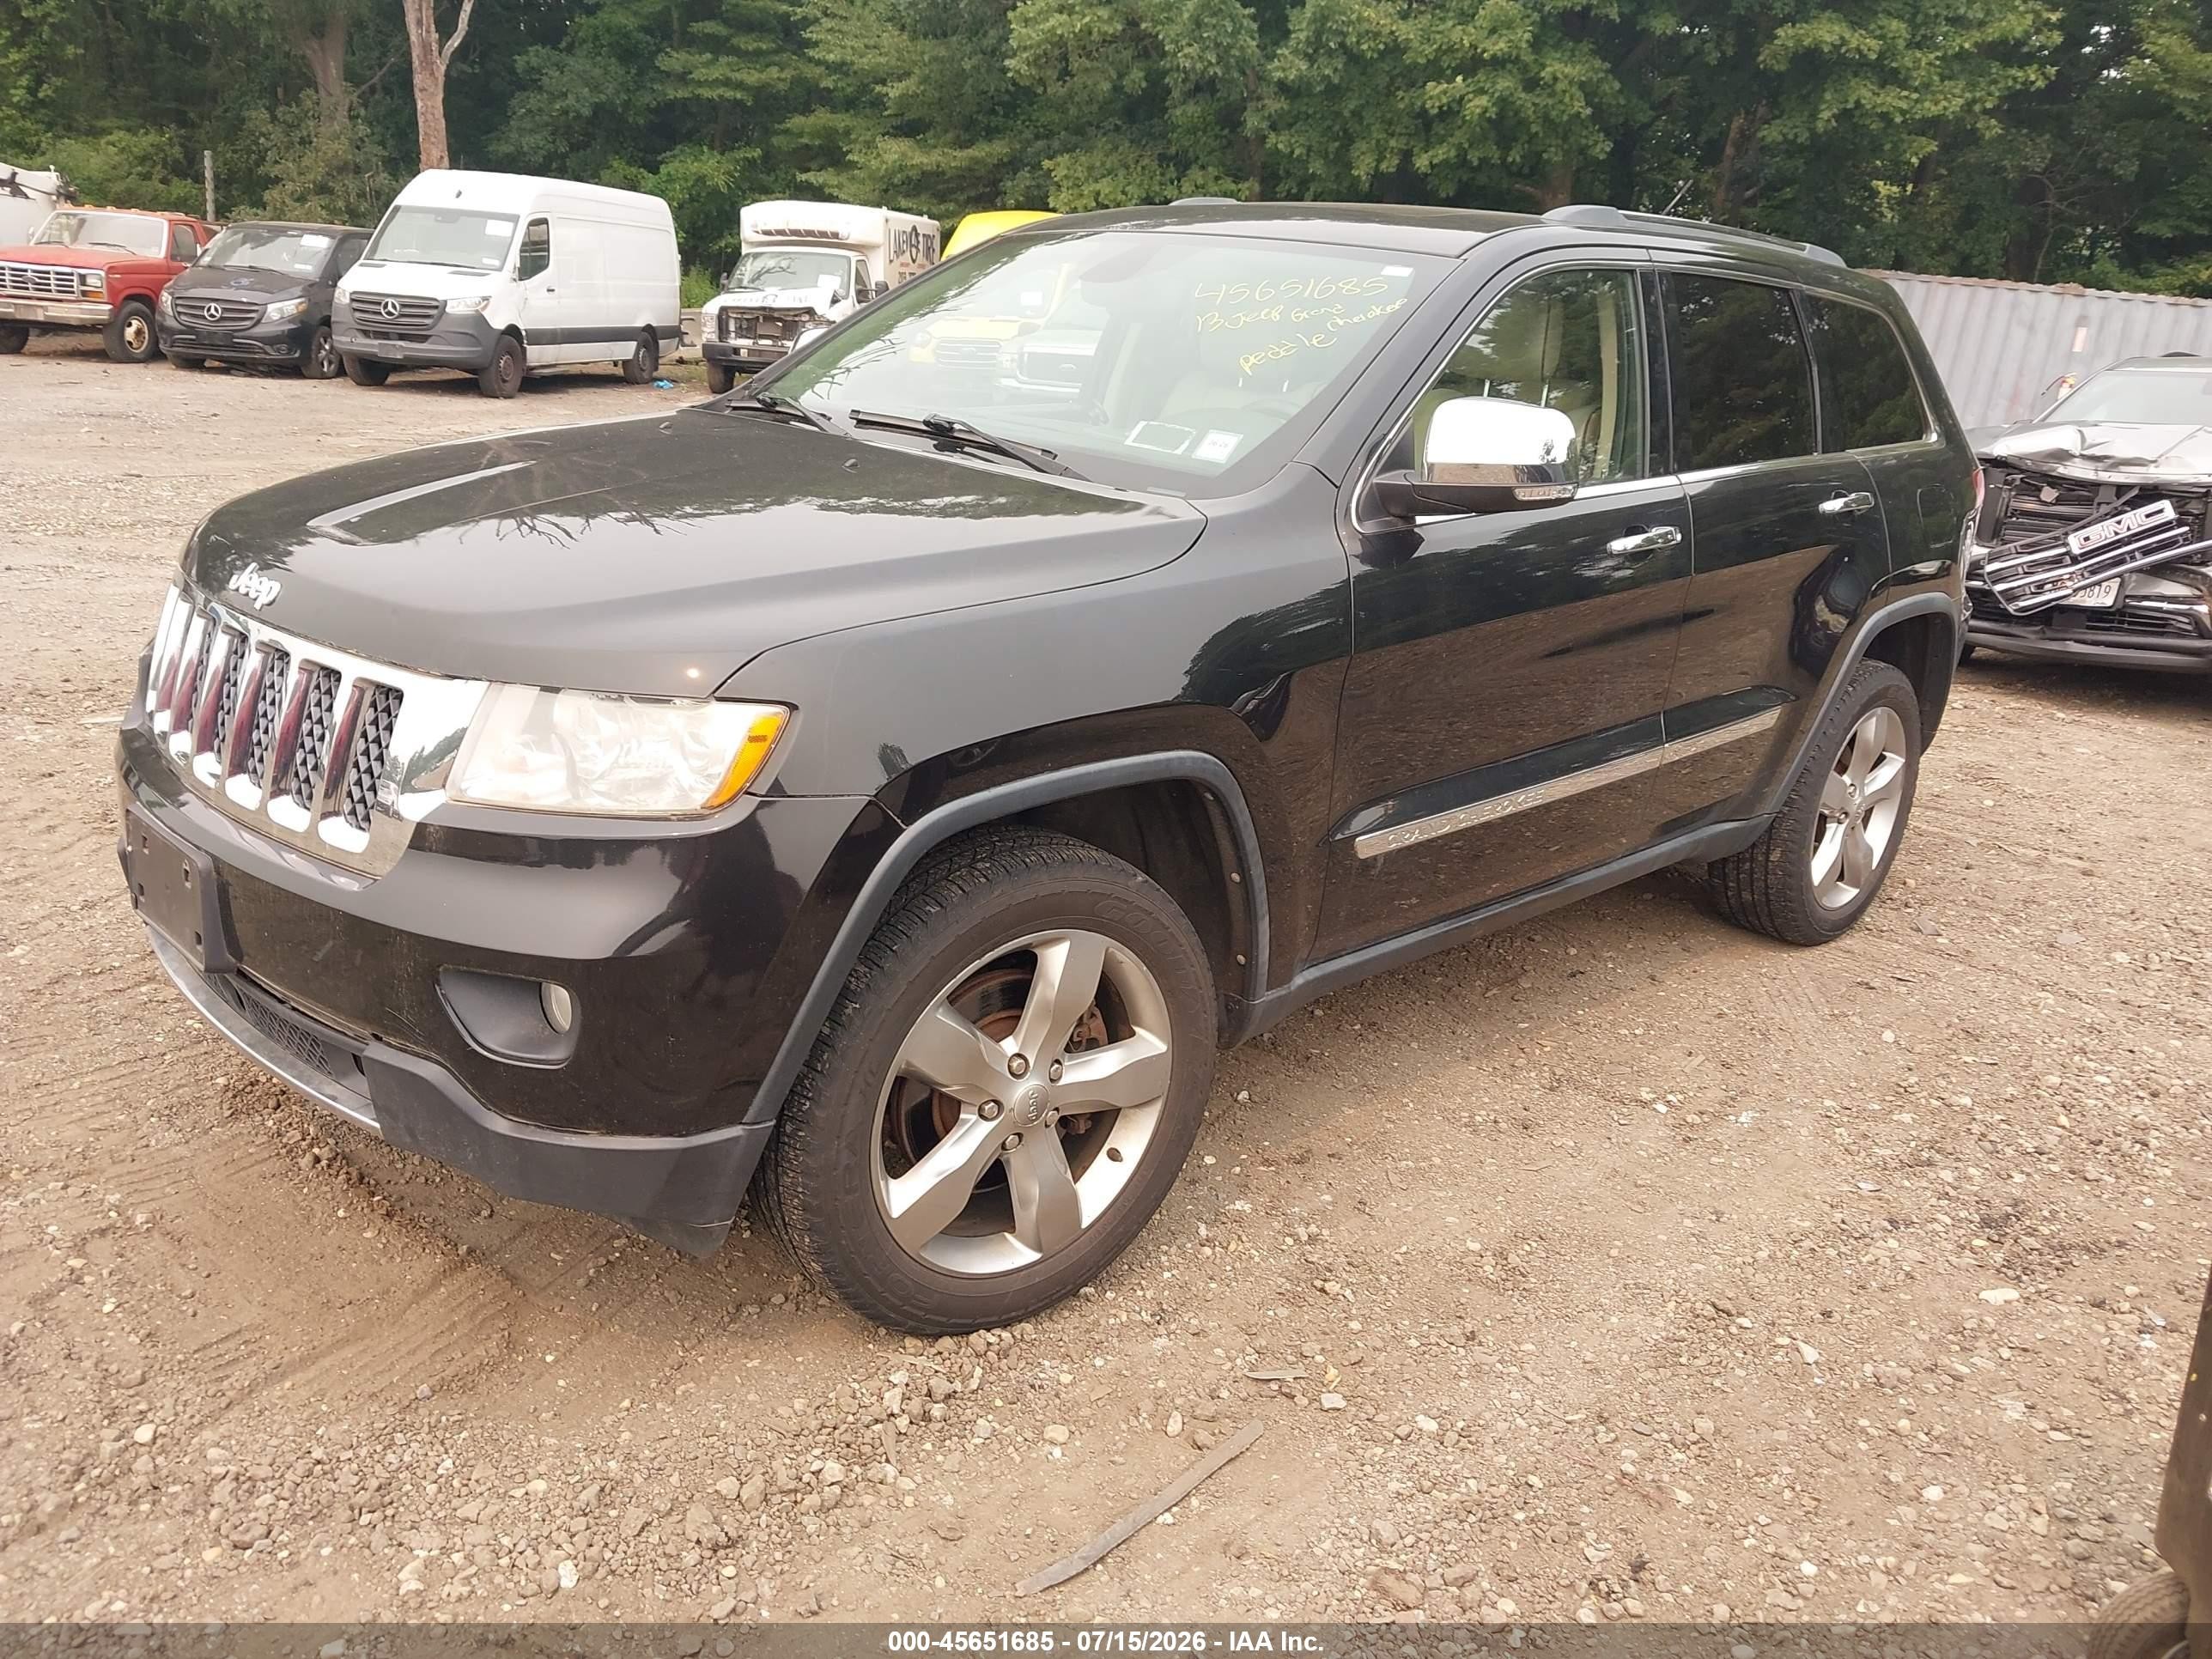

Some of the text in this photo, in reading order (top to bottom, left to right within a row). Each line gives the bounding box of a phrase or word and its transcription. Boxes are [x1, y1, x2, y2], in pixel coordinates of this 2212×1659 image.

[1195, 277, 1389, 305] 45651685
[2074, 505, 2170, 550] GMC
[229, 562, 281, 611] Jeep
[1028, 1091, 1038, 1121] Jeep
